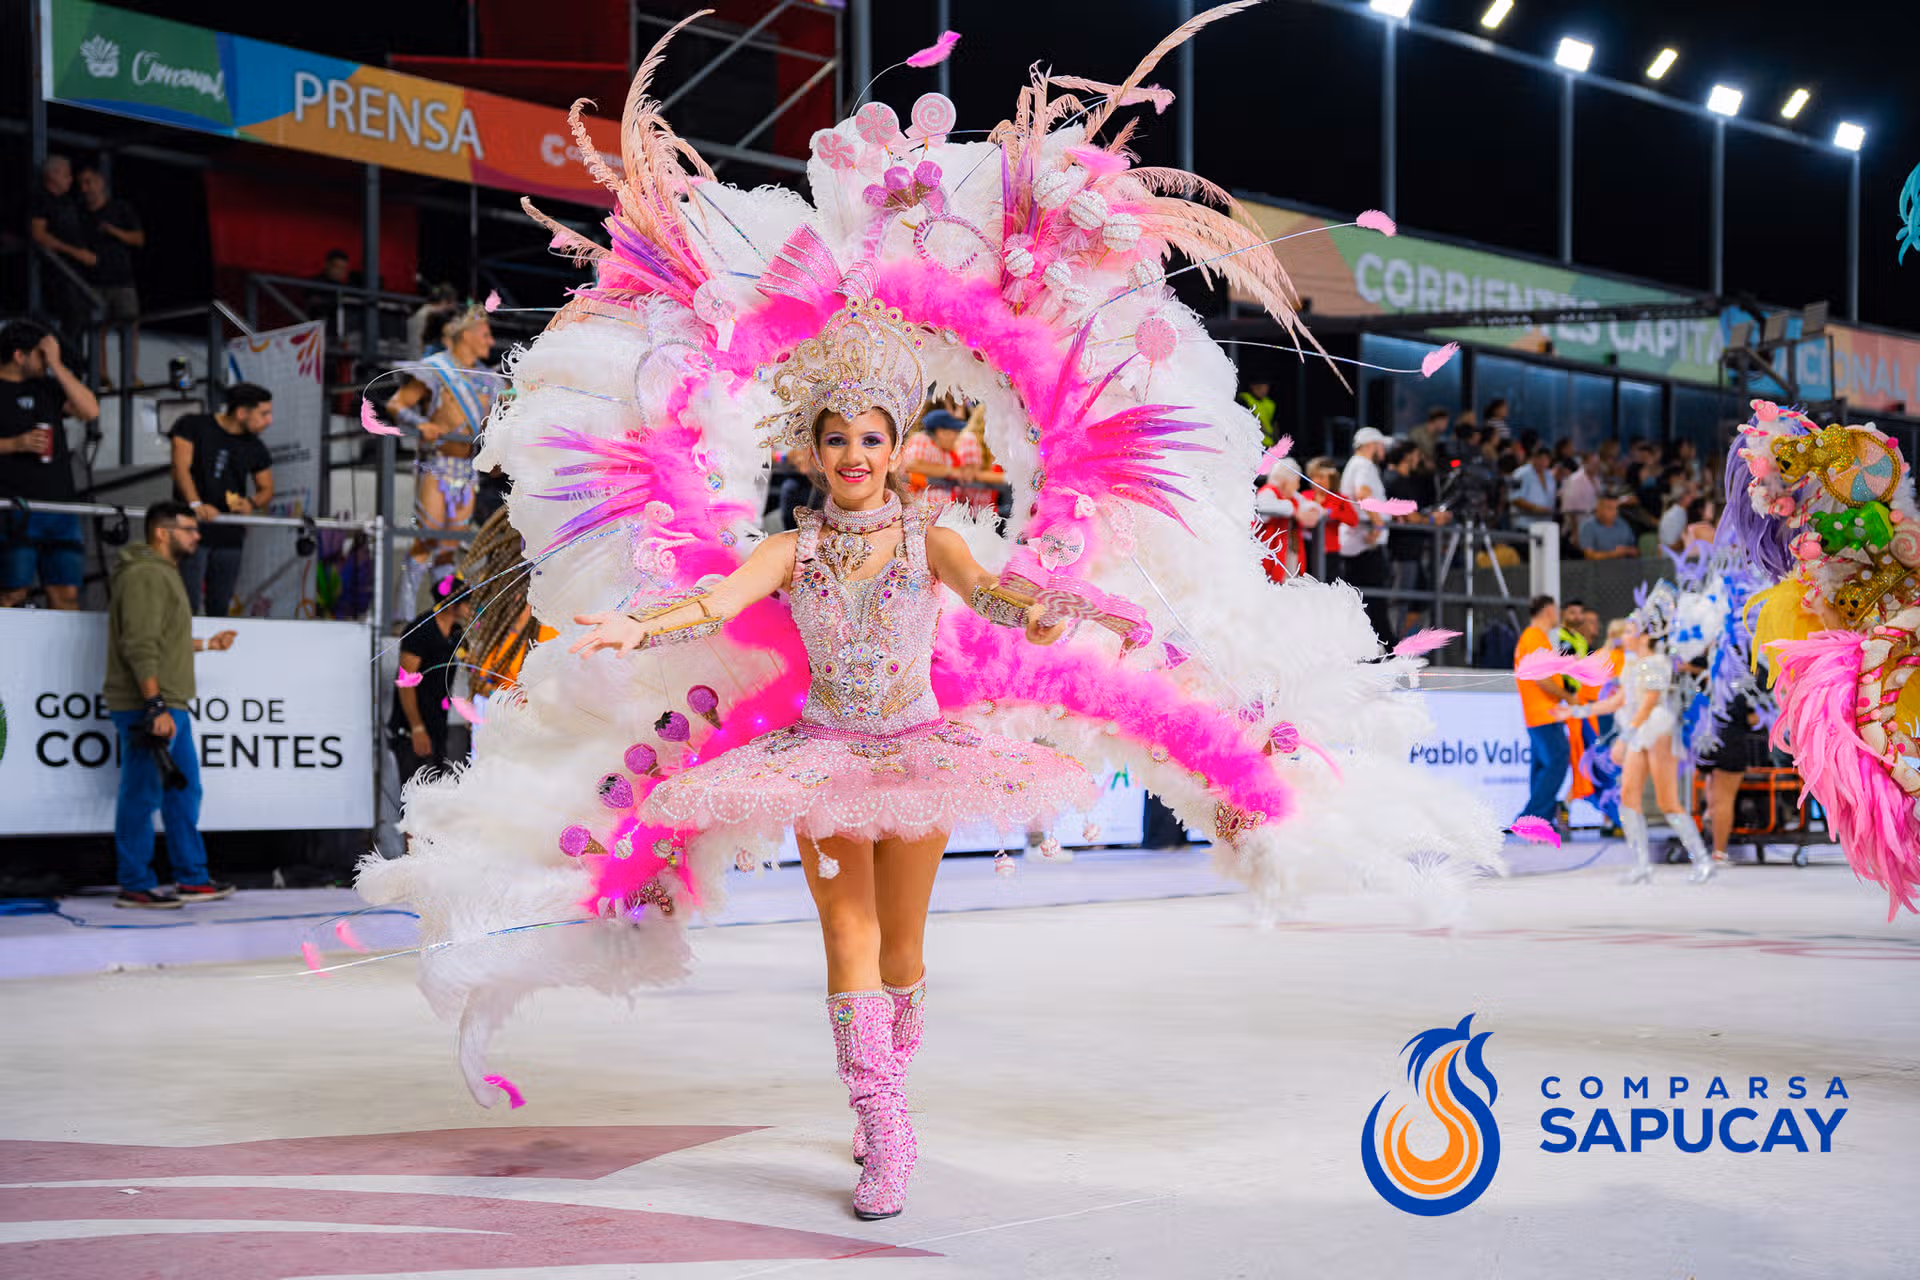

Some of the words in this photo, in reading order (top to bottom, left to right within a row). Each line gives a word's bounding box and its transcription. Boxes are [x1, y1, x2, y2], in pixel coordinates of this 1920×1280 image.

[294, 71, 484, 160] PRENSA
[1607, 311, 1725, 366] CAPITA
[35, 693, 229, 722] GOBNO
[242, 698, 285, 723] DE
[36, 731, 343, 769] COENTES
